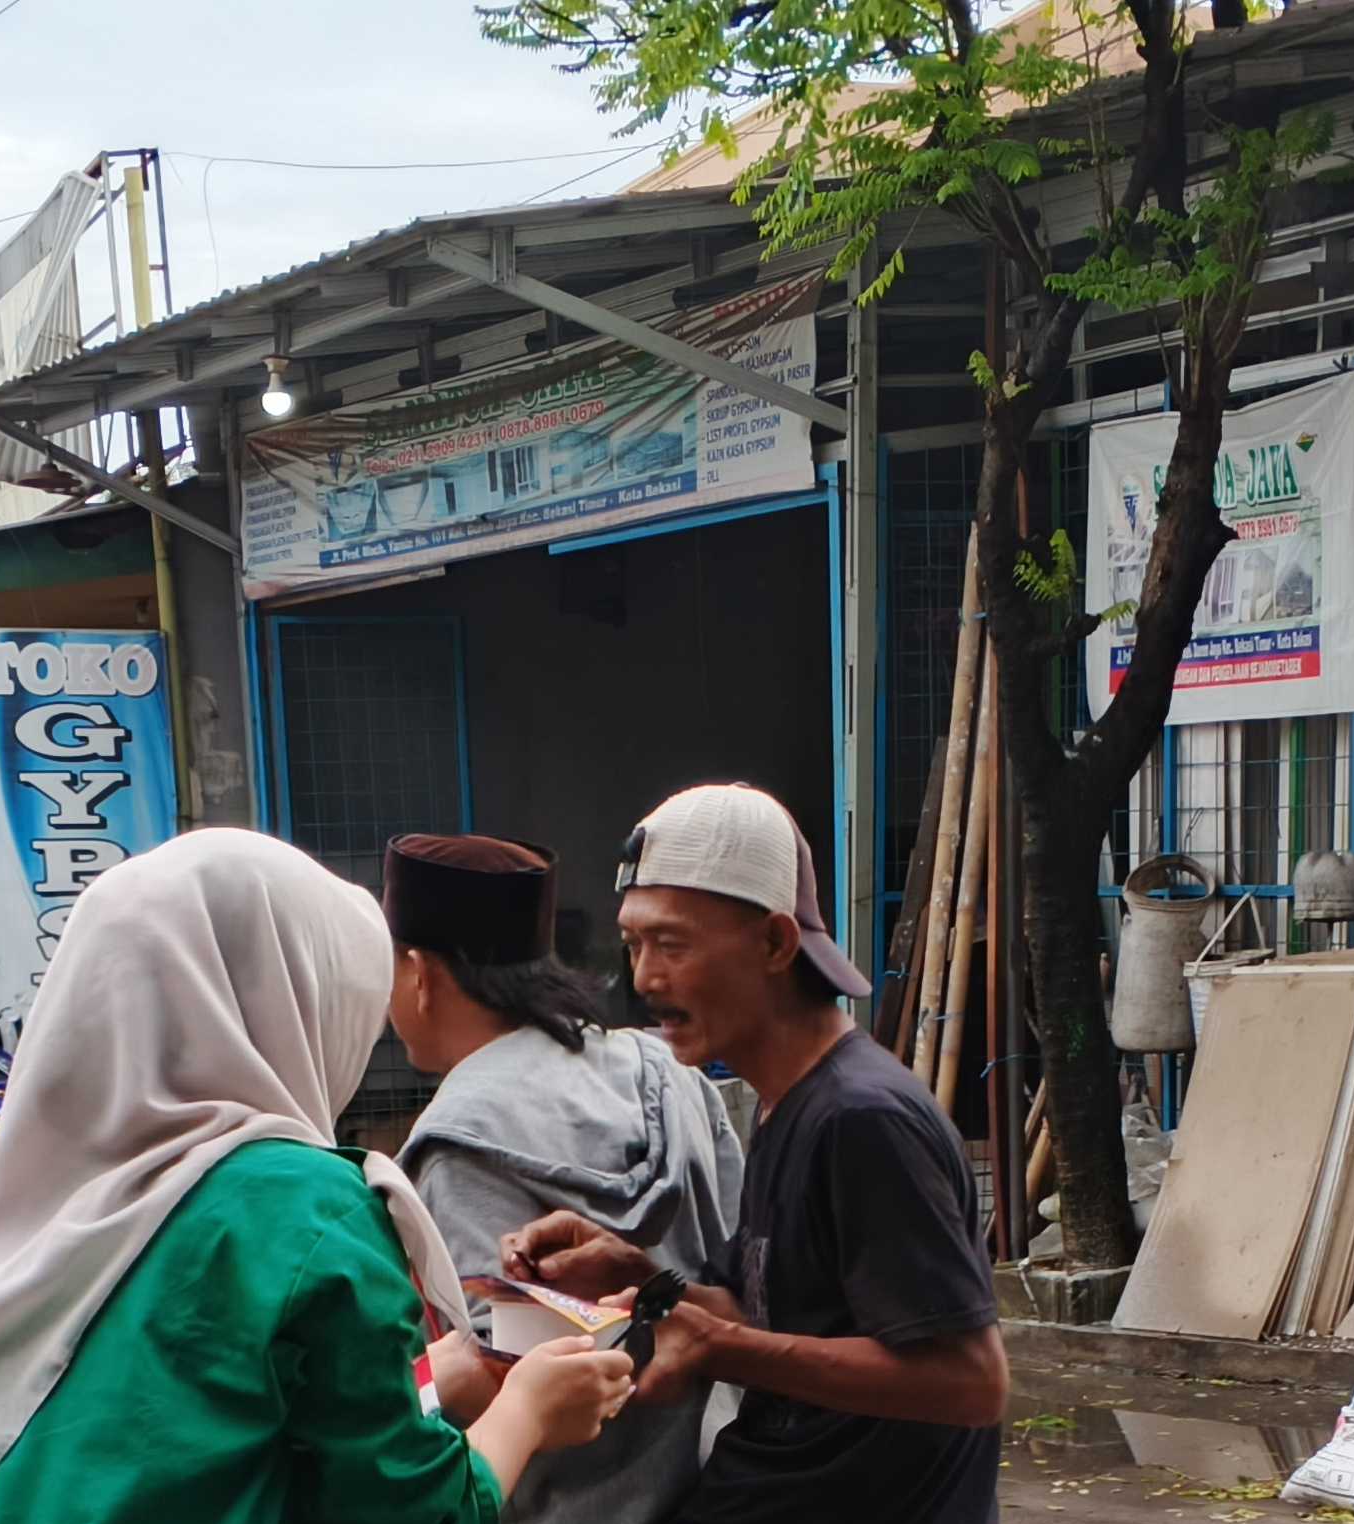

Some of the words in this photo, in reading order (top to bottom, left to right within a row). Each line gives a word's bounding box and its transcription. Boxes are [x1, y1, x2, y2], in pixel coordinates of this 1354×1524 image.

[617, 488, 644, 504] Kota
[645, 477, 682, 498] Bekasi
[1246, 443, 1300, 506] JAYA
